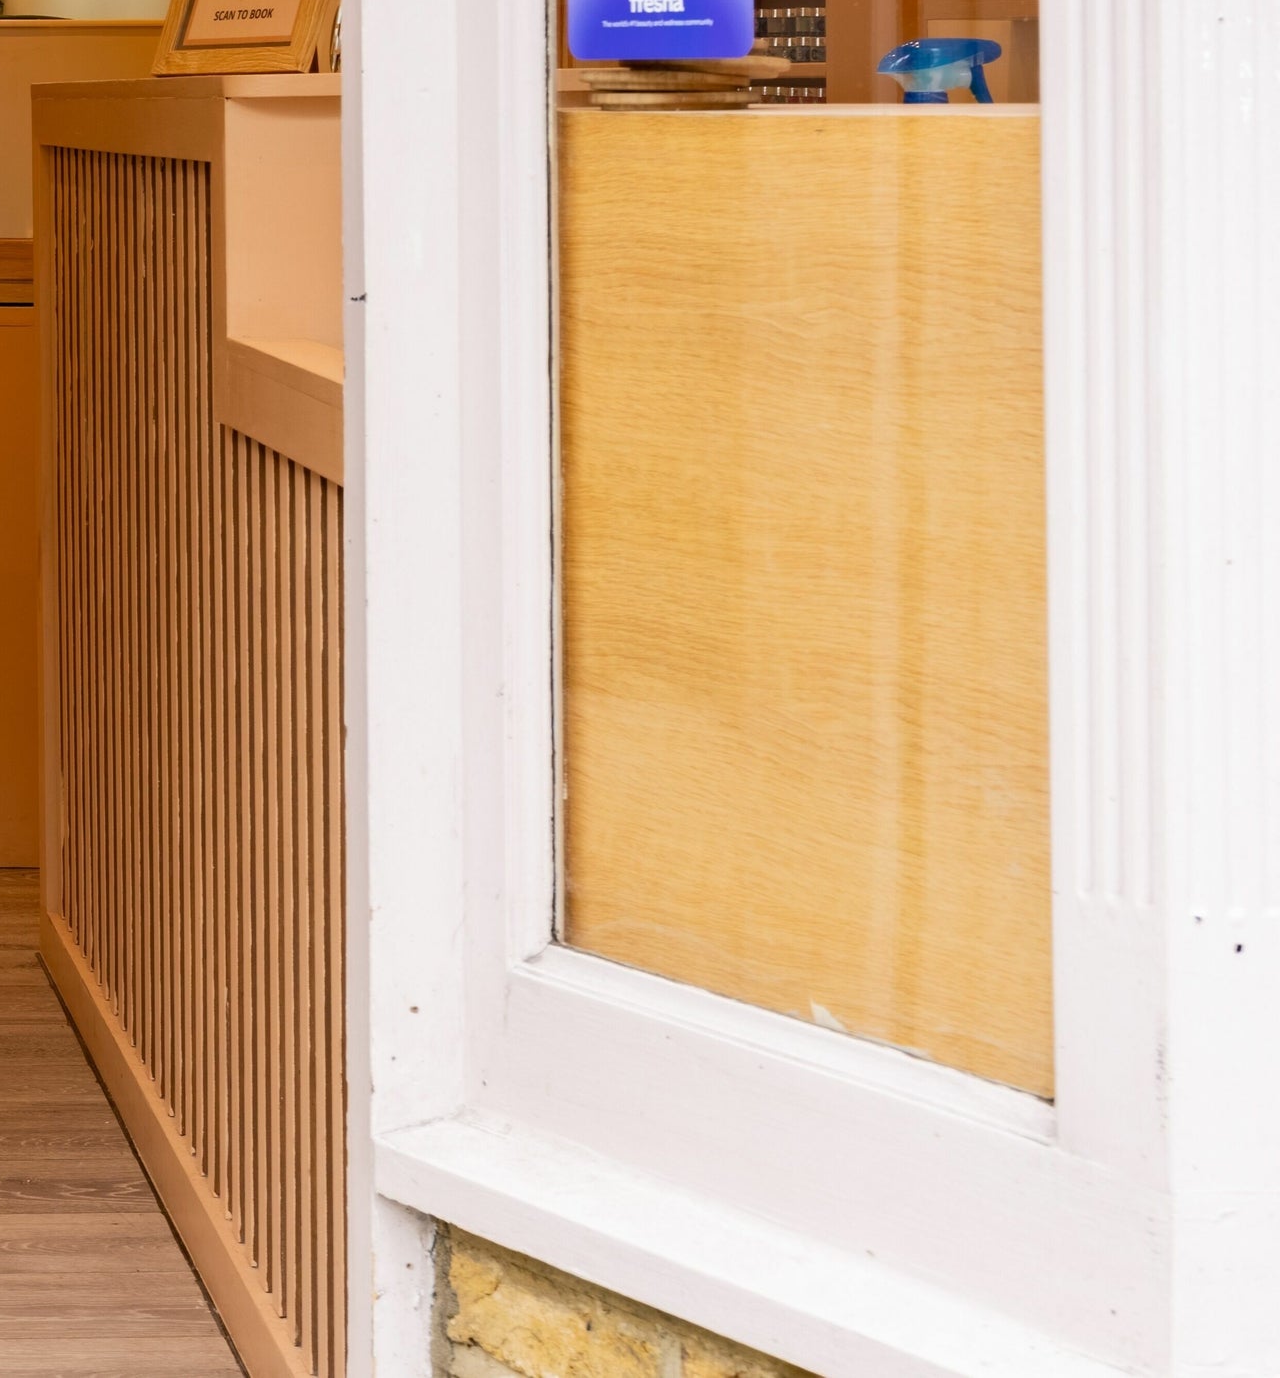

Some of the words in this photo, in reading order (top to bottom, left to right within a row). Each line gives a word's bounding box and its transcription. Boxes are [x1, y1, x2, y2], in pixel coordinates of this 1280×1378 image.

[214, 9, 235, 21] SCAN
[237, 9, 248, 21] TO
[250, 8, 274, 20] BOOK
